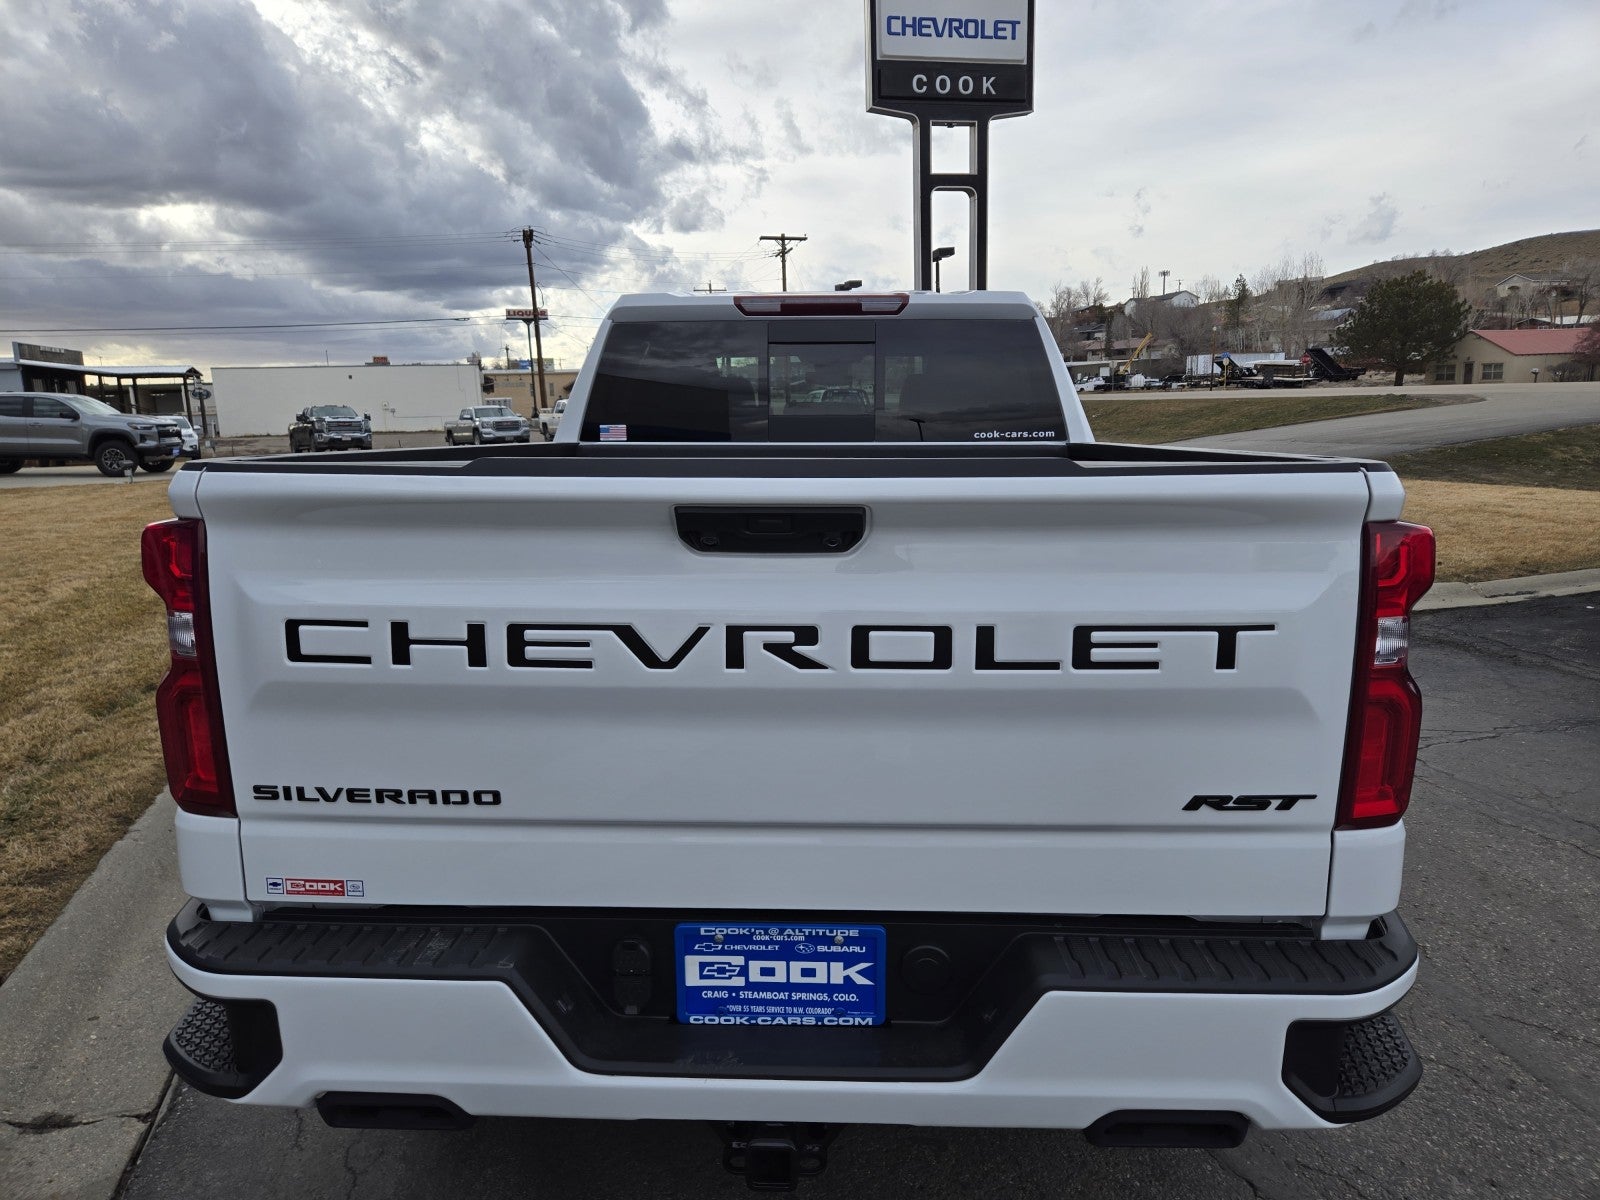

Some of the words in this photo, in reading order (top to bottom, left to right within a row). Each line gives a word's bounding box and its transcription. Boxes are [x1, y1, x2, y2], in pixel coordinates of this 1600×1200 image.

[886, 15, 1021, 40] CHEVROLET
[912, 74, 997, 95] COOK
[973, 430, 1055, 439] cook-cars.com
[285, 618, 1276, 671] CHEVROLET
[252, 784, 502, 806] SILVERADO
[1181, 794, 1318, 811] RST
[286, 880, 344, 891] COOK
[768, 927, 780, 936] @
[783, 928, 860, 937] ALTITUDE
[816, 945, 866, 953] SUBARU
[684, 955, 875, 986] COOK
[701, 990, 729, 999] CRAIG
[739, 991, 789, 1000] STEAMBOAT
[791, 992, 831, 1003] SPRINGS,
[832, 993, 859, 1002] COLO.
[750, 1005, 765, 1013] YEARS
[689, 1015, 873, 1025] COOK-CARS.COM
